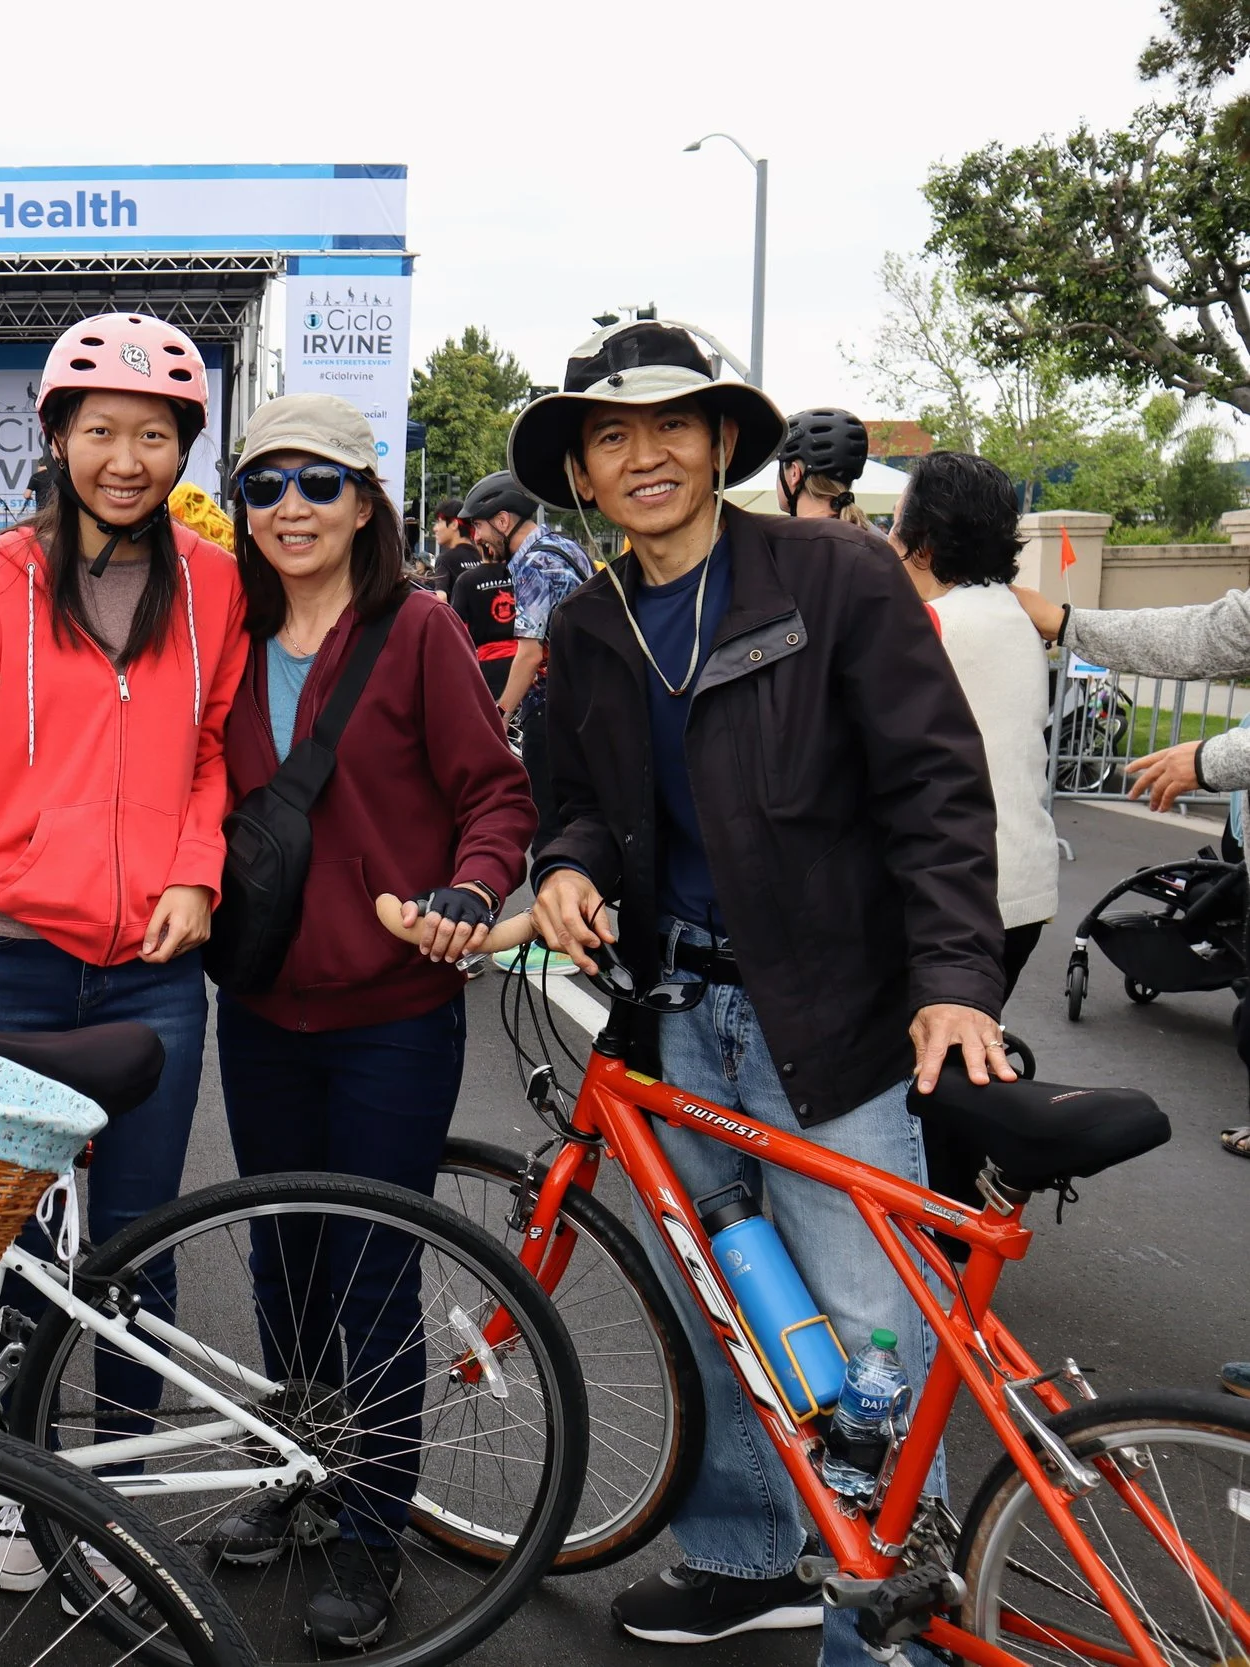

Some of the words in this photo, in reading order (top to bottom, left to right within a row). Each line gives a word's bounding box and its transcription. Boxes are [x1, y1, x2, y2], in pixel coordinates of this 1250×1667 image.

[327, 308, 392, 331] Ciclo
[303, 334, 392, 354] IRVINE
[363, 410, 388, 419] ocial!
[682, 1103, 761, 1140] OUTPOST
[119, 1530, 161, 1568] KWICK
[155, 1566, 205, 1620] BITUMEN
